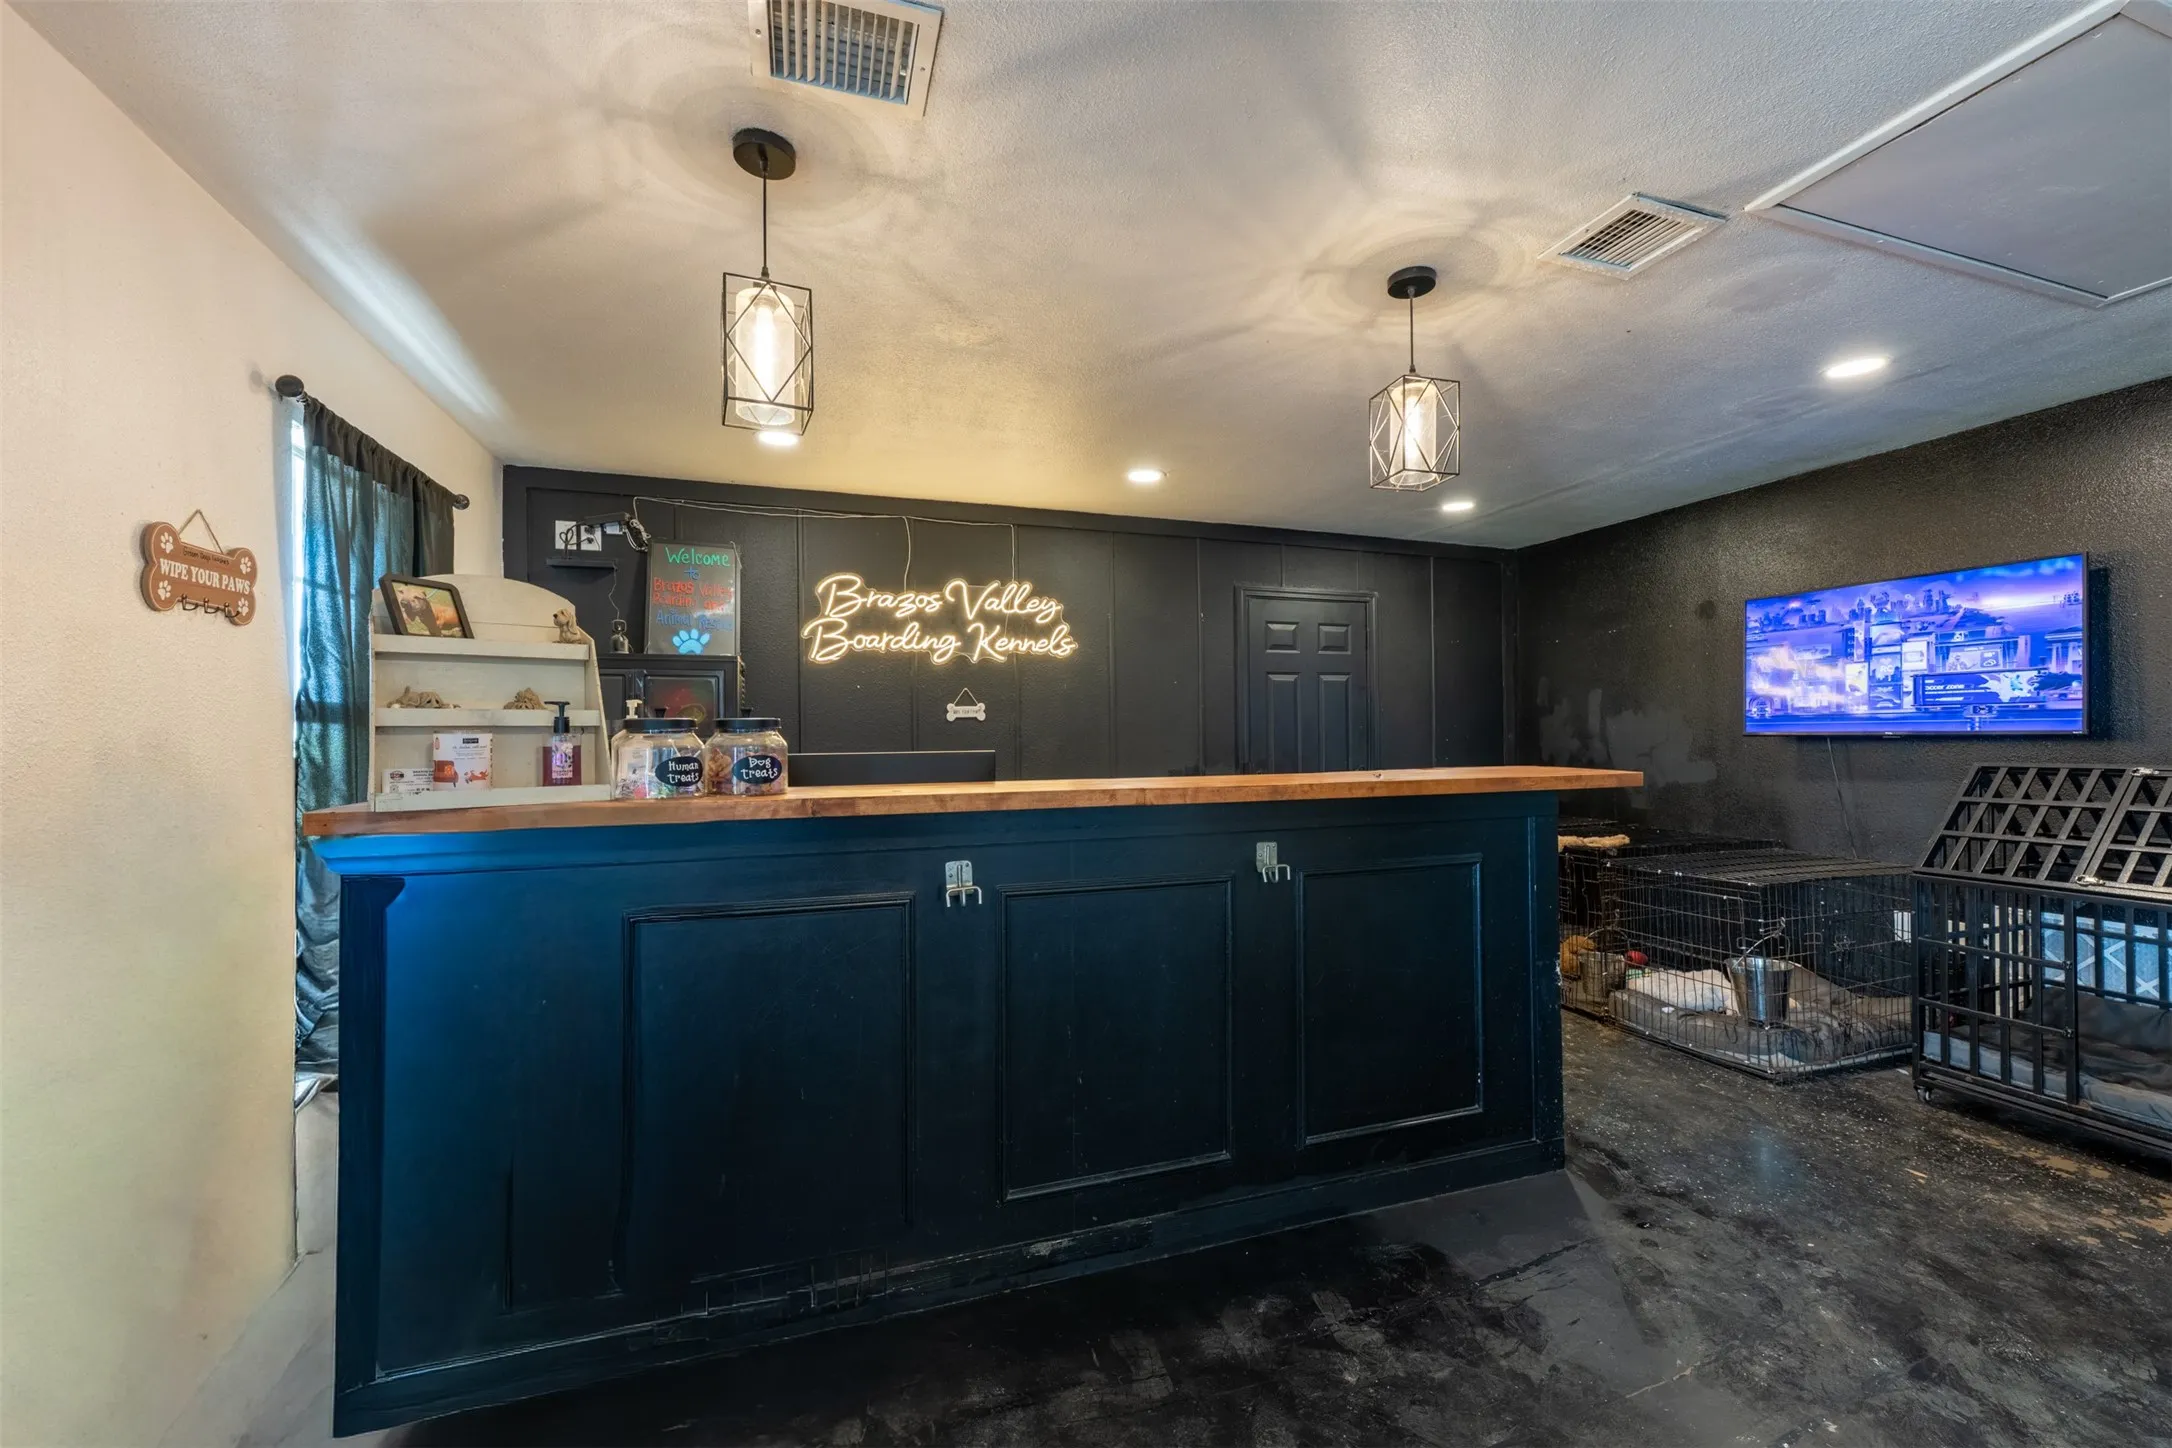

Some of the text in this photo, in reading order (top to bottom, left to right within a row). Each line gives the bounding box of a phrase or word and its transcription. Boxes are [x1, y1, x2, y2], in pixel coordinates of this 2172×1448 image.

[665, 546, 730, 567] Welcome
[160, 558, 251, 595] WIPE YOUR PAWS
[684, 565, 700, 580] to
[653, 577, 695, 595] Brazos
[817, 573, 1061, 623] Brazos Valley
[656, 608, 692, 626] Animal
[803, 617, 1077, 662] Boarding Kennels
[668, 759, 700, 772] Human
[749, 756, 771, 768] Dog
[667, 772, 700, 784] treats
[740, 767, 779, 779] treats
